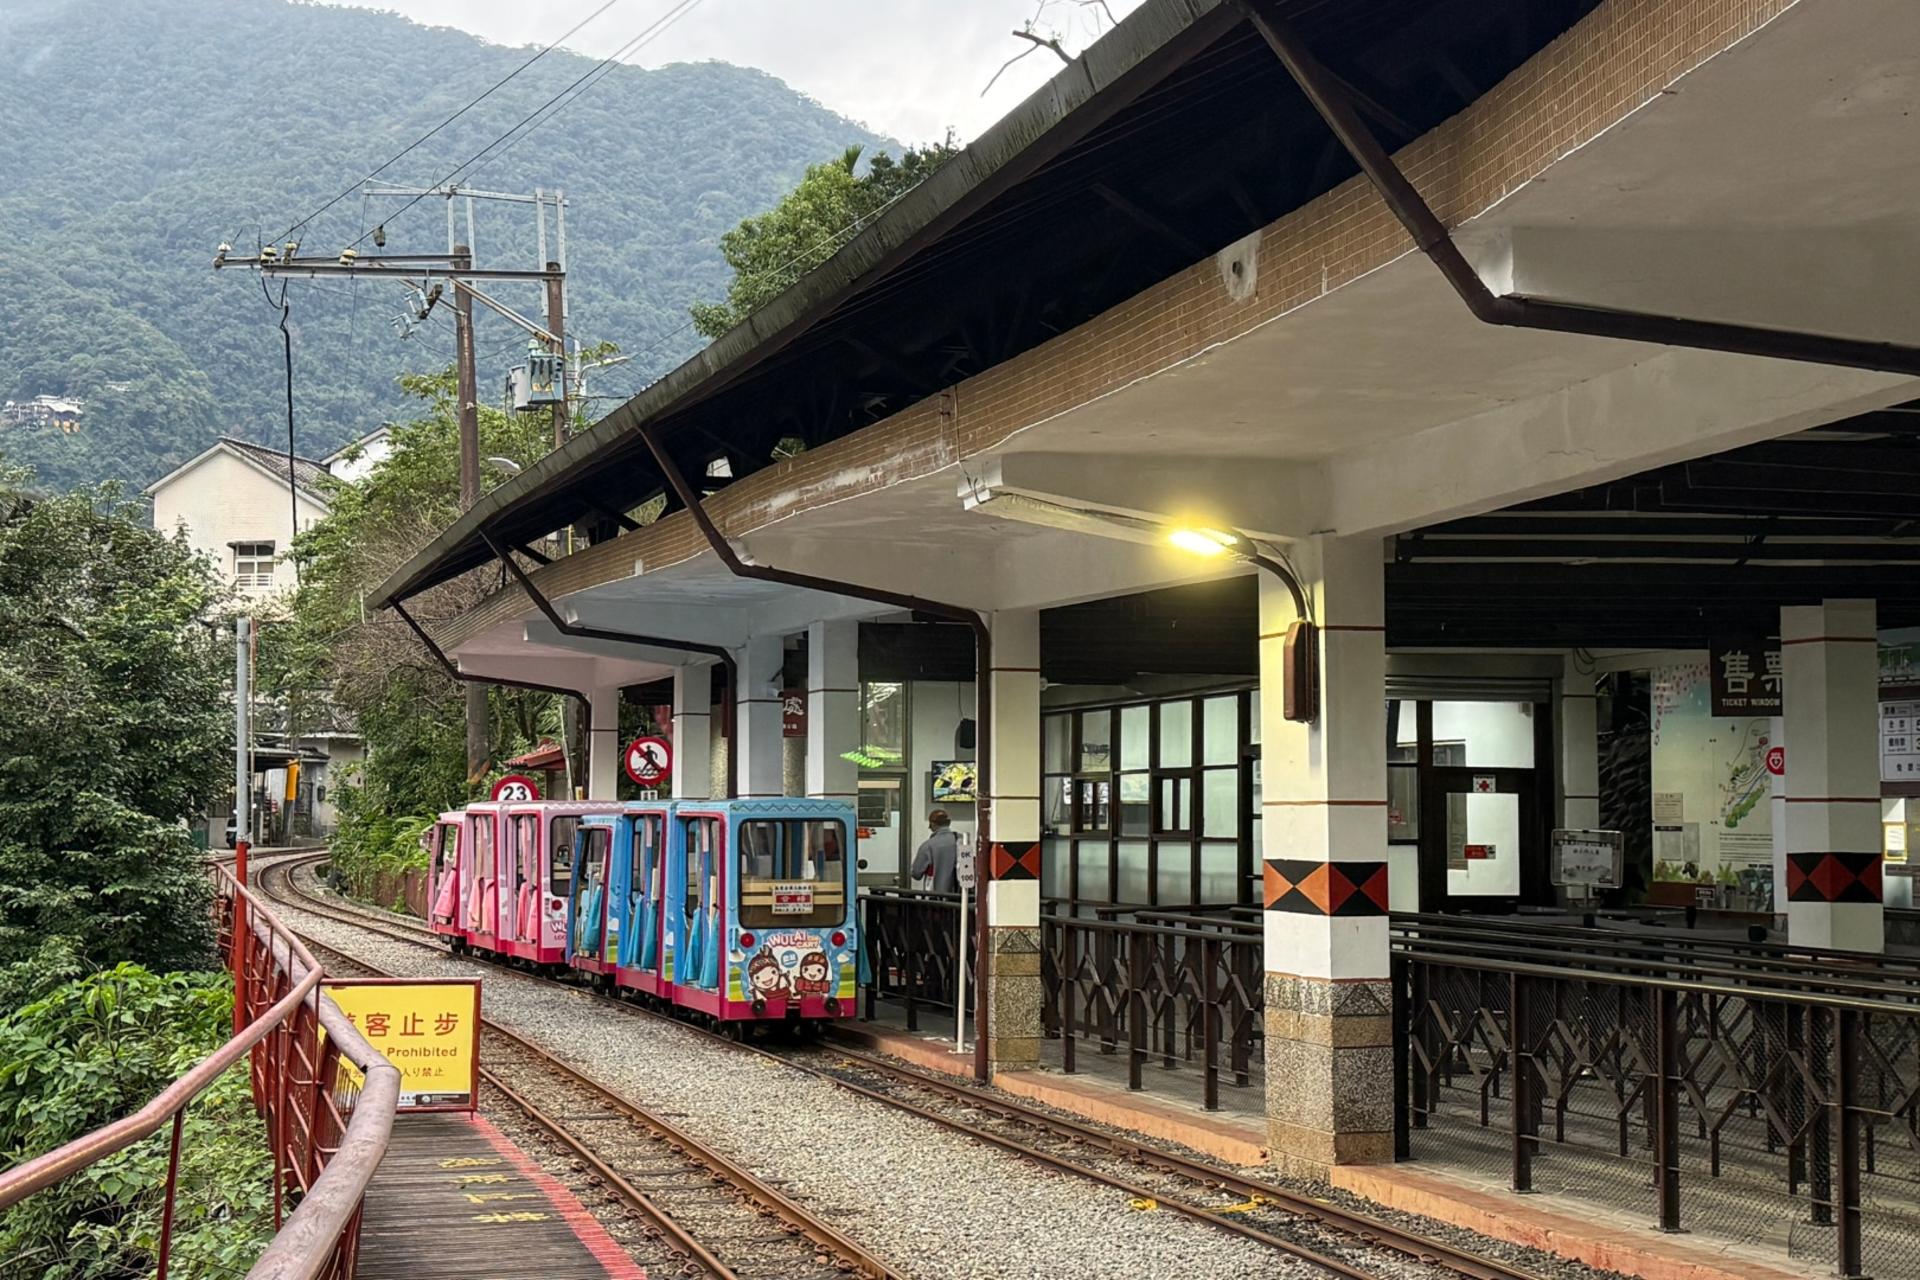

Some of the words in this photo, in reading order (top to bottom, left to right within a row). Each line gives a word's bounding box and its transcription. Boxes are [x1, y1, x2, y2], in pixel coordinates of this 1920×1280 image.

[1721, 698, 1747, 707] TICKET
[503, 785, 527, 800] 23
[768, 929, 807, 947] WULAI
[387, 1046, 457, 1057] Prohibited
